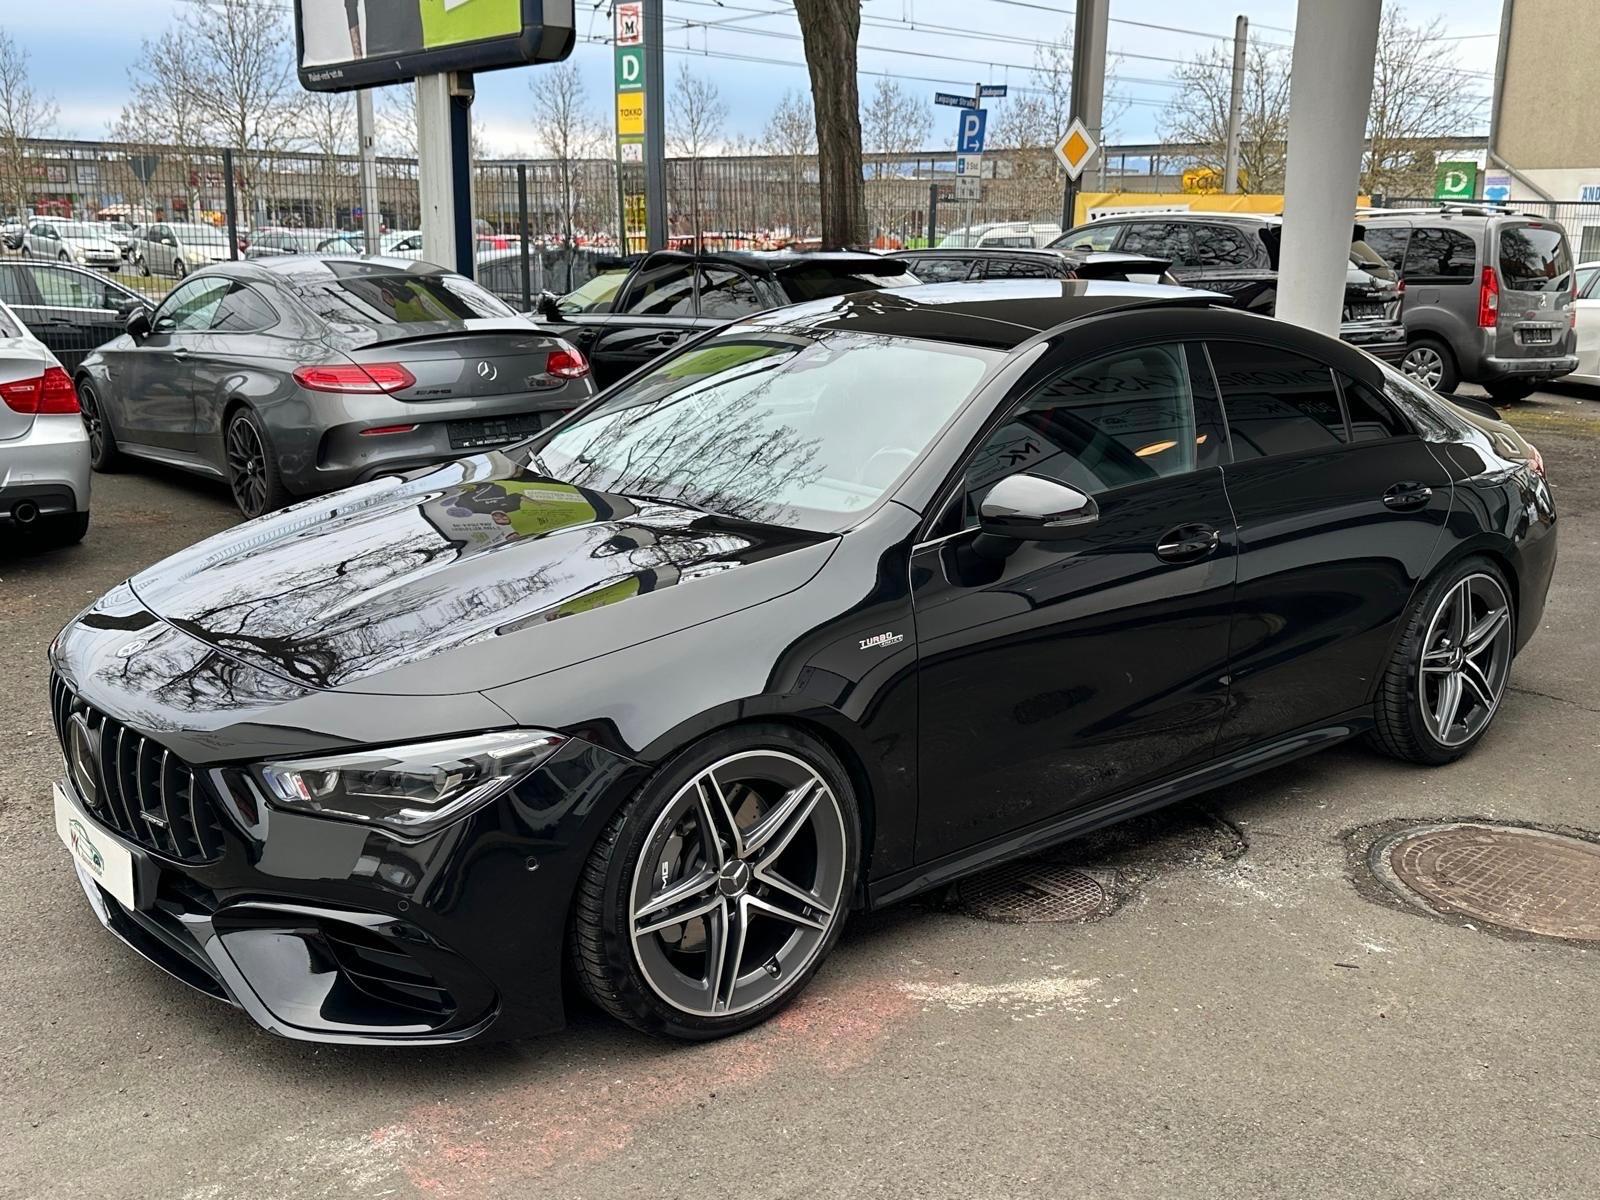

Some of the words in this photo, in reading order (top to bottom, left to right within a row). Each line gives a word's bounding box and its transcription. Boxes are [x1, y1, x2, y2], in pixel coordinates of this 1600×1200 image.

[622, 55, 640, 81] D
[935, 94, 959, 106] Leipziger
[620, 107, 643, 117] TOKKO
[963, 114, 980, 150] P
[1444, 171, 1468, 192] D
[859, 631, 893, 648] TURBO
